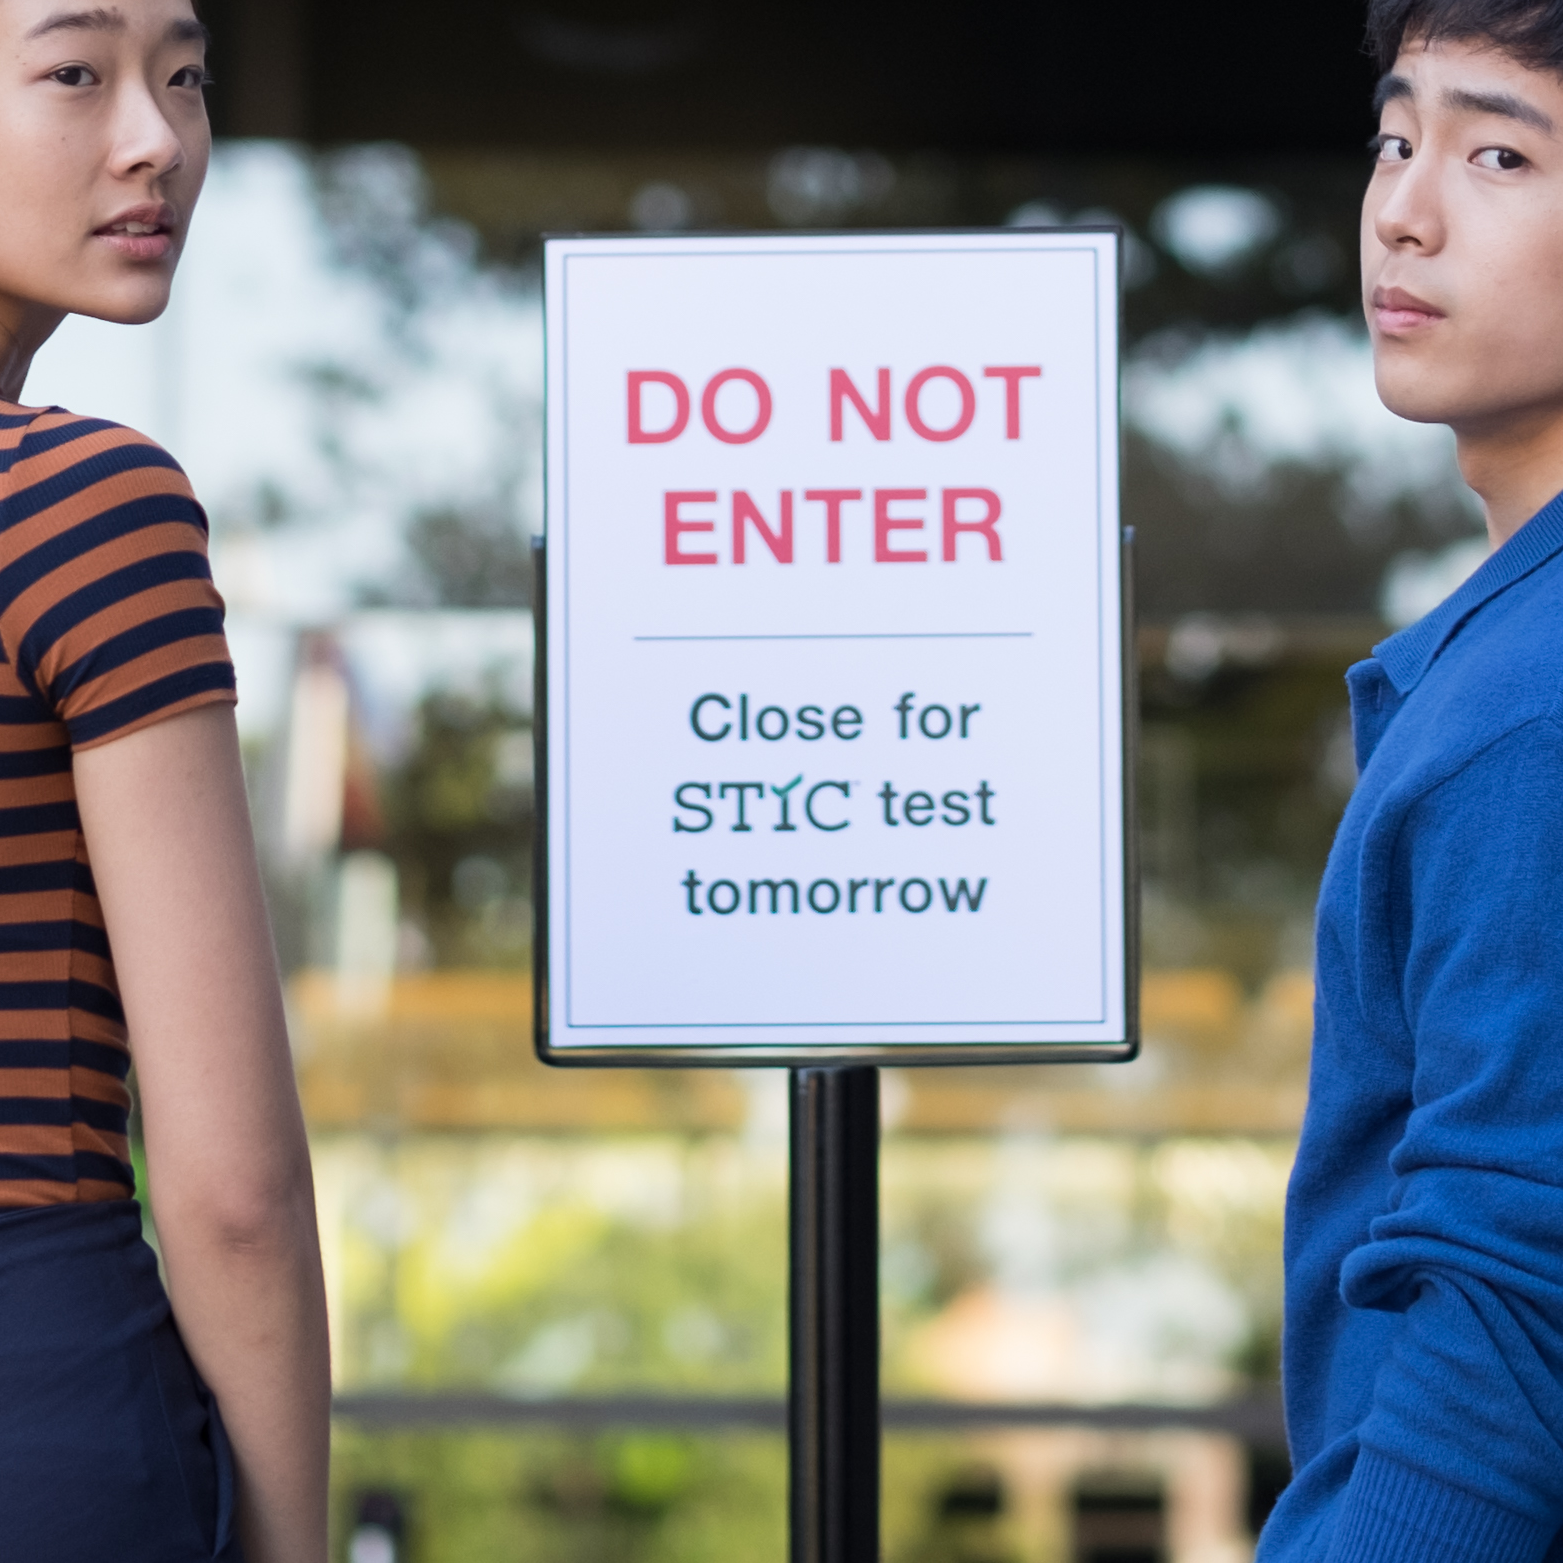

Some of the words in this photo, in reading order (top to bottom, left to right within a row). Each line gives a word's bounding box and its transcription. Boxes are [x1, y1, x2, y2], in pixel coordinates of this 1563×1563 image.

[626, 367, 773, 445] DO
[829, 364, 1042, 443] NOT
[663, 487, 1004, 566] ENTER
[688, 692, 864, 743] Close
[892, 691, 982, 741] for
[876, 779, 997, 828] test
[679, 868, 989, 917] tomorrow
